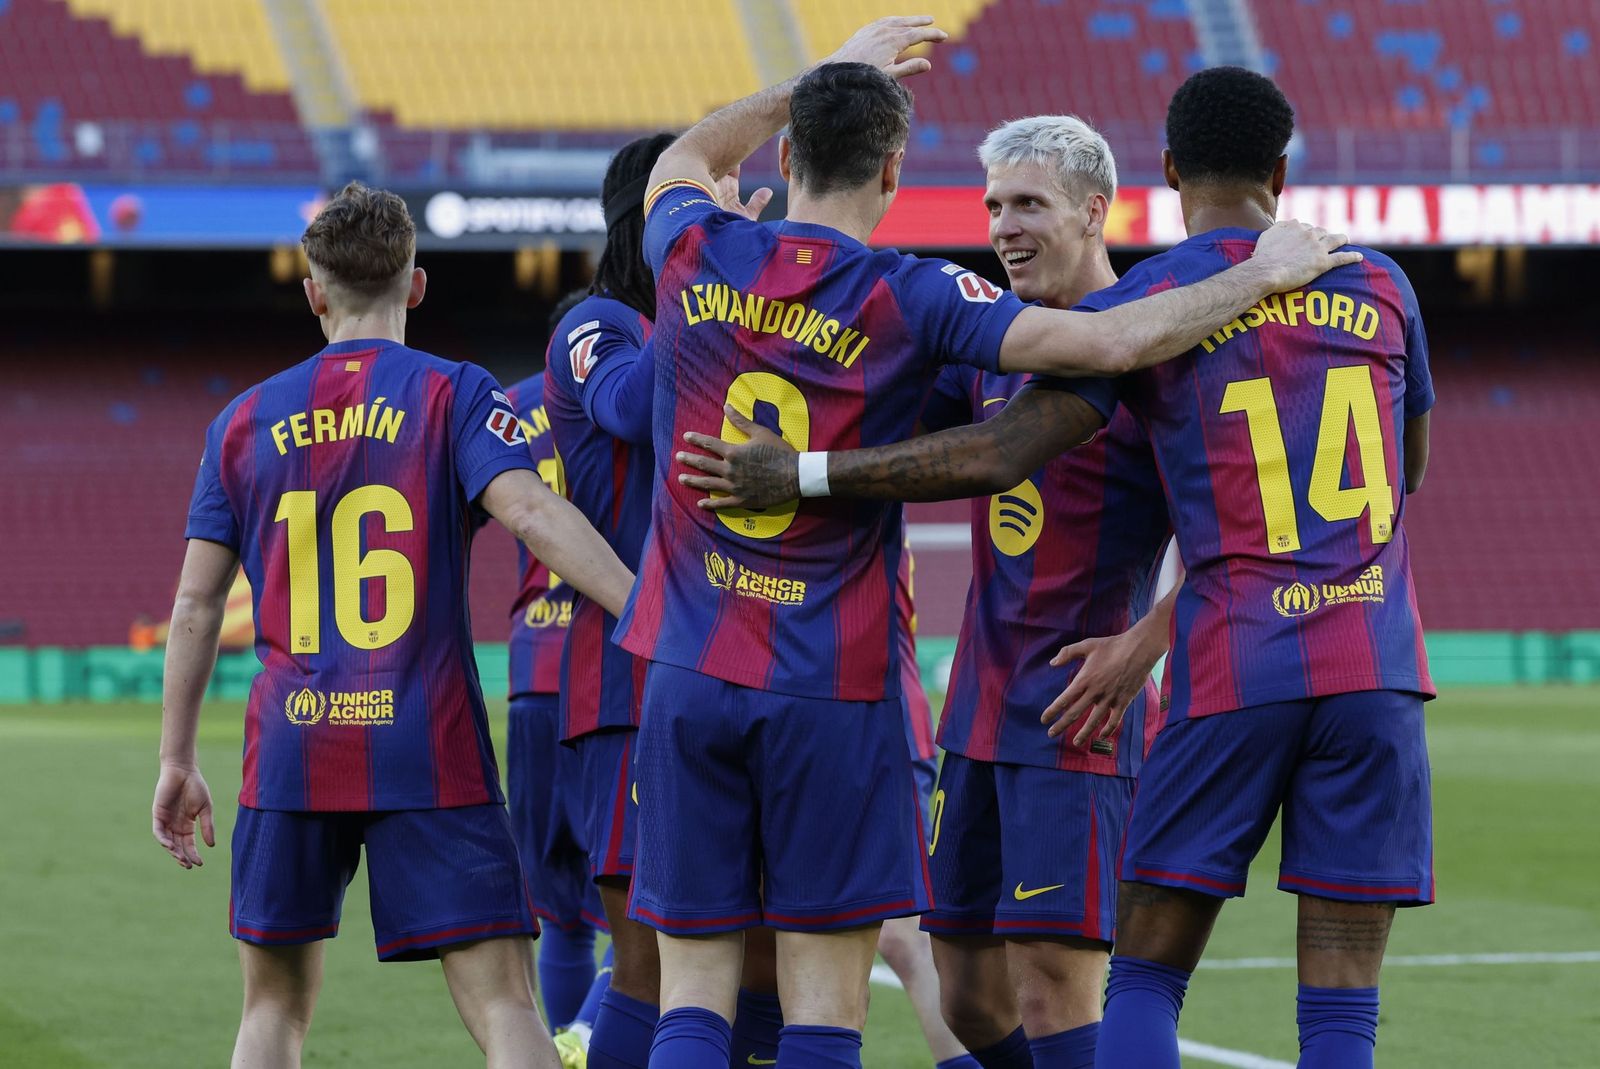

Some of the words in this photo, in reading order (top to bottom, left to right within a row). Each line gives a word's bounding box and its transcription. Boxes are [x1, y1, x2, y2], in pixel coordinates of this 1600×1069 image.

[681, 284, 870, 368] LEWANDOWSKI
[270, 397, 405, 456] FERMÍN
[1219, 364, 1394, 554] 14
[274, 484, 415, 654] 16
[736, 575, 804, 602] ACNUR
[738, 564, 806, 593] UNHCR
[328, 704, 394, 719] ACNUR
[329, 689, 394, 706] UNHCR
